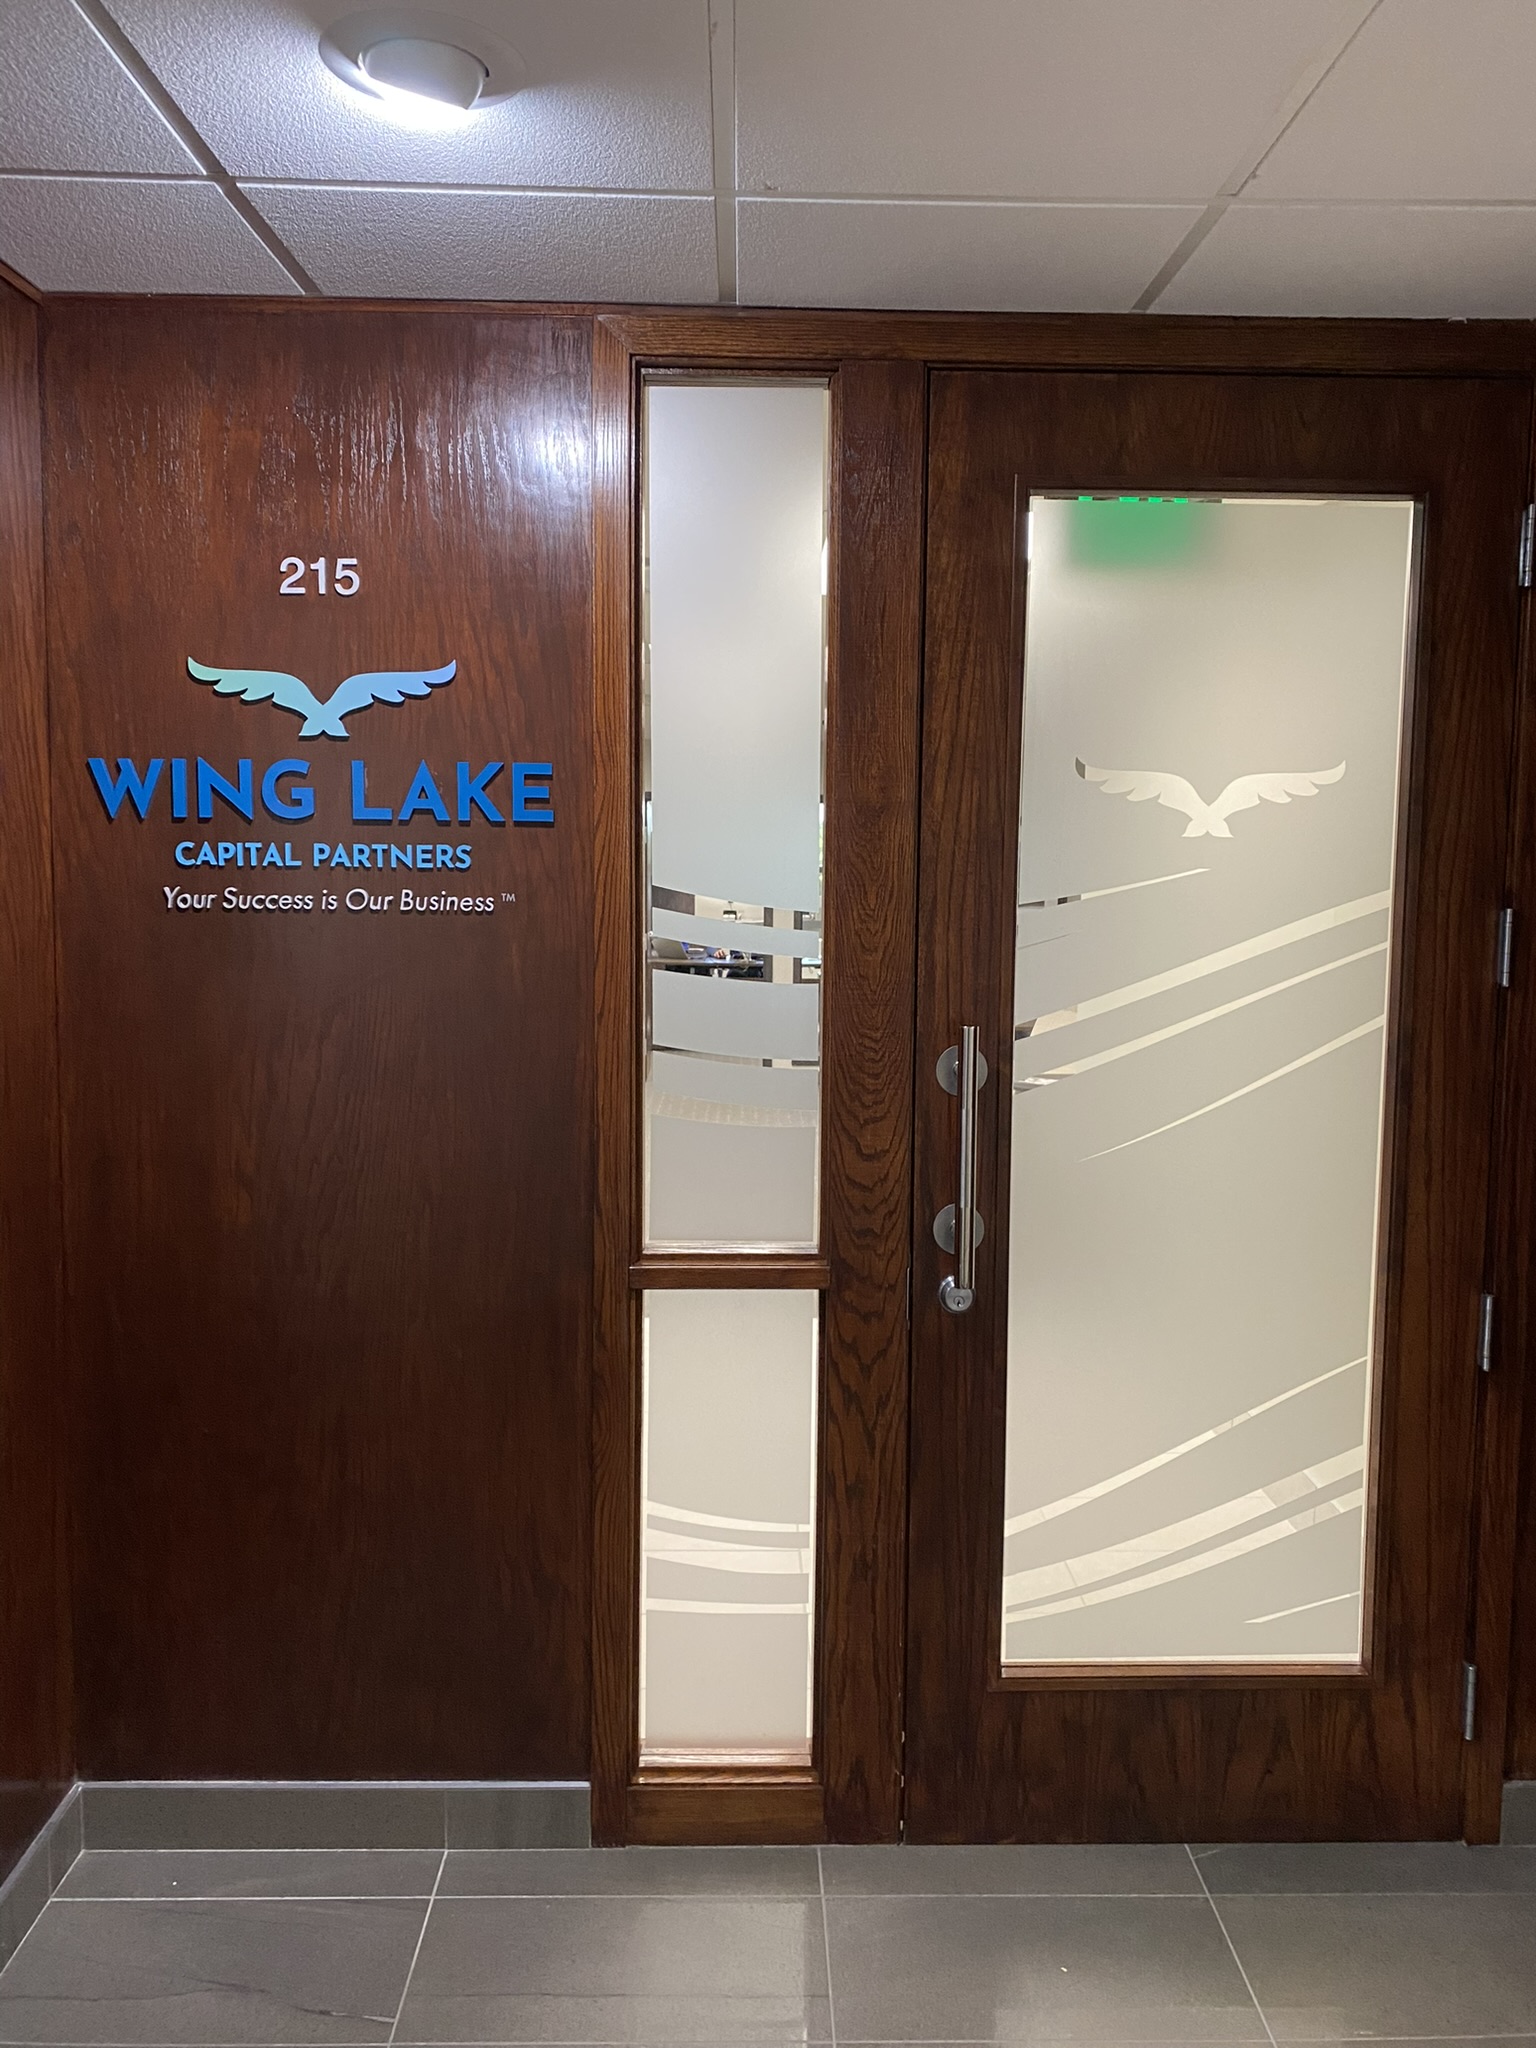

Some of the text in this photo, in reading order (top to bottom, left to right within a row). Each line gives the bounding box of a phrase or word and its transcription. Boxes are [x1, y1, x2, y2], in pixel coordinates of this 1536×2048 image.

[279, 556, 361, 595] 215
[86, 757, 556, 822] WING LAKE
[174, 841, 473, 869] CAPITAL PARTNERS
[163, 885, 217, 911] Your
[222, 886, 313, 912] Success
[320, 888, 338, 912] is
[345, 888, 394, 912] Our
[399, 889, 495, 914] Business
